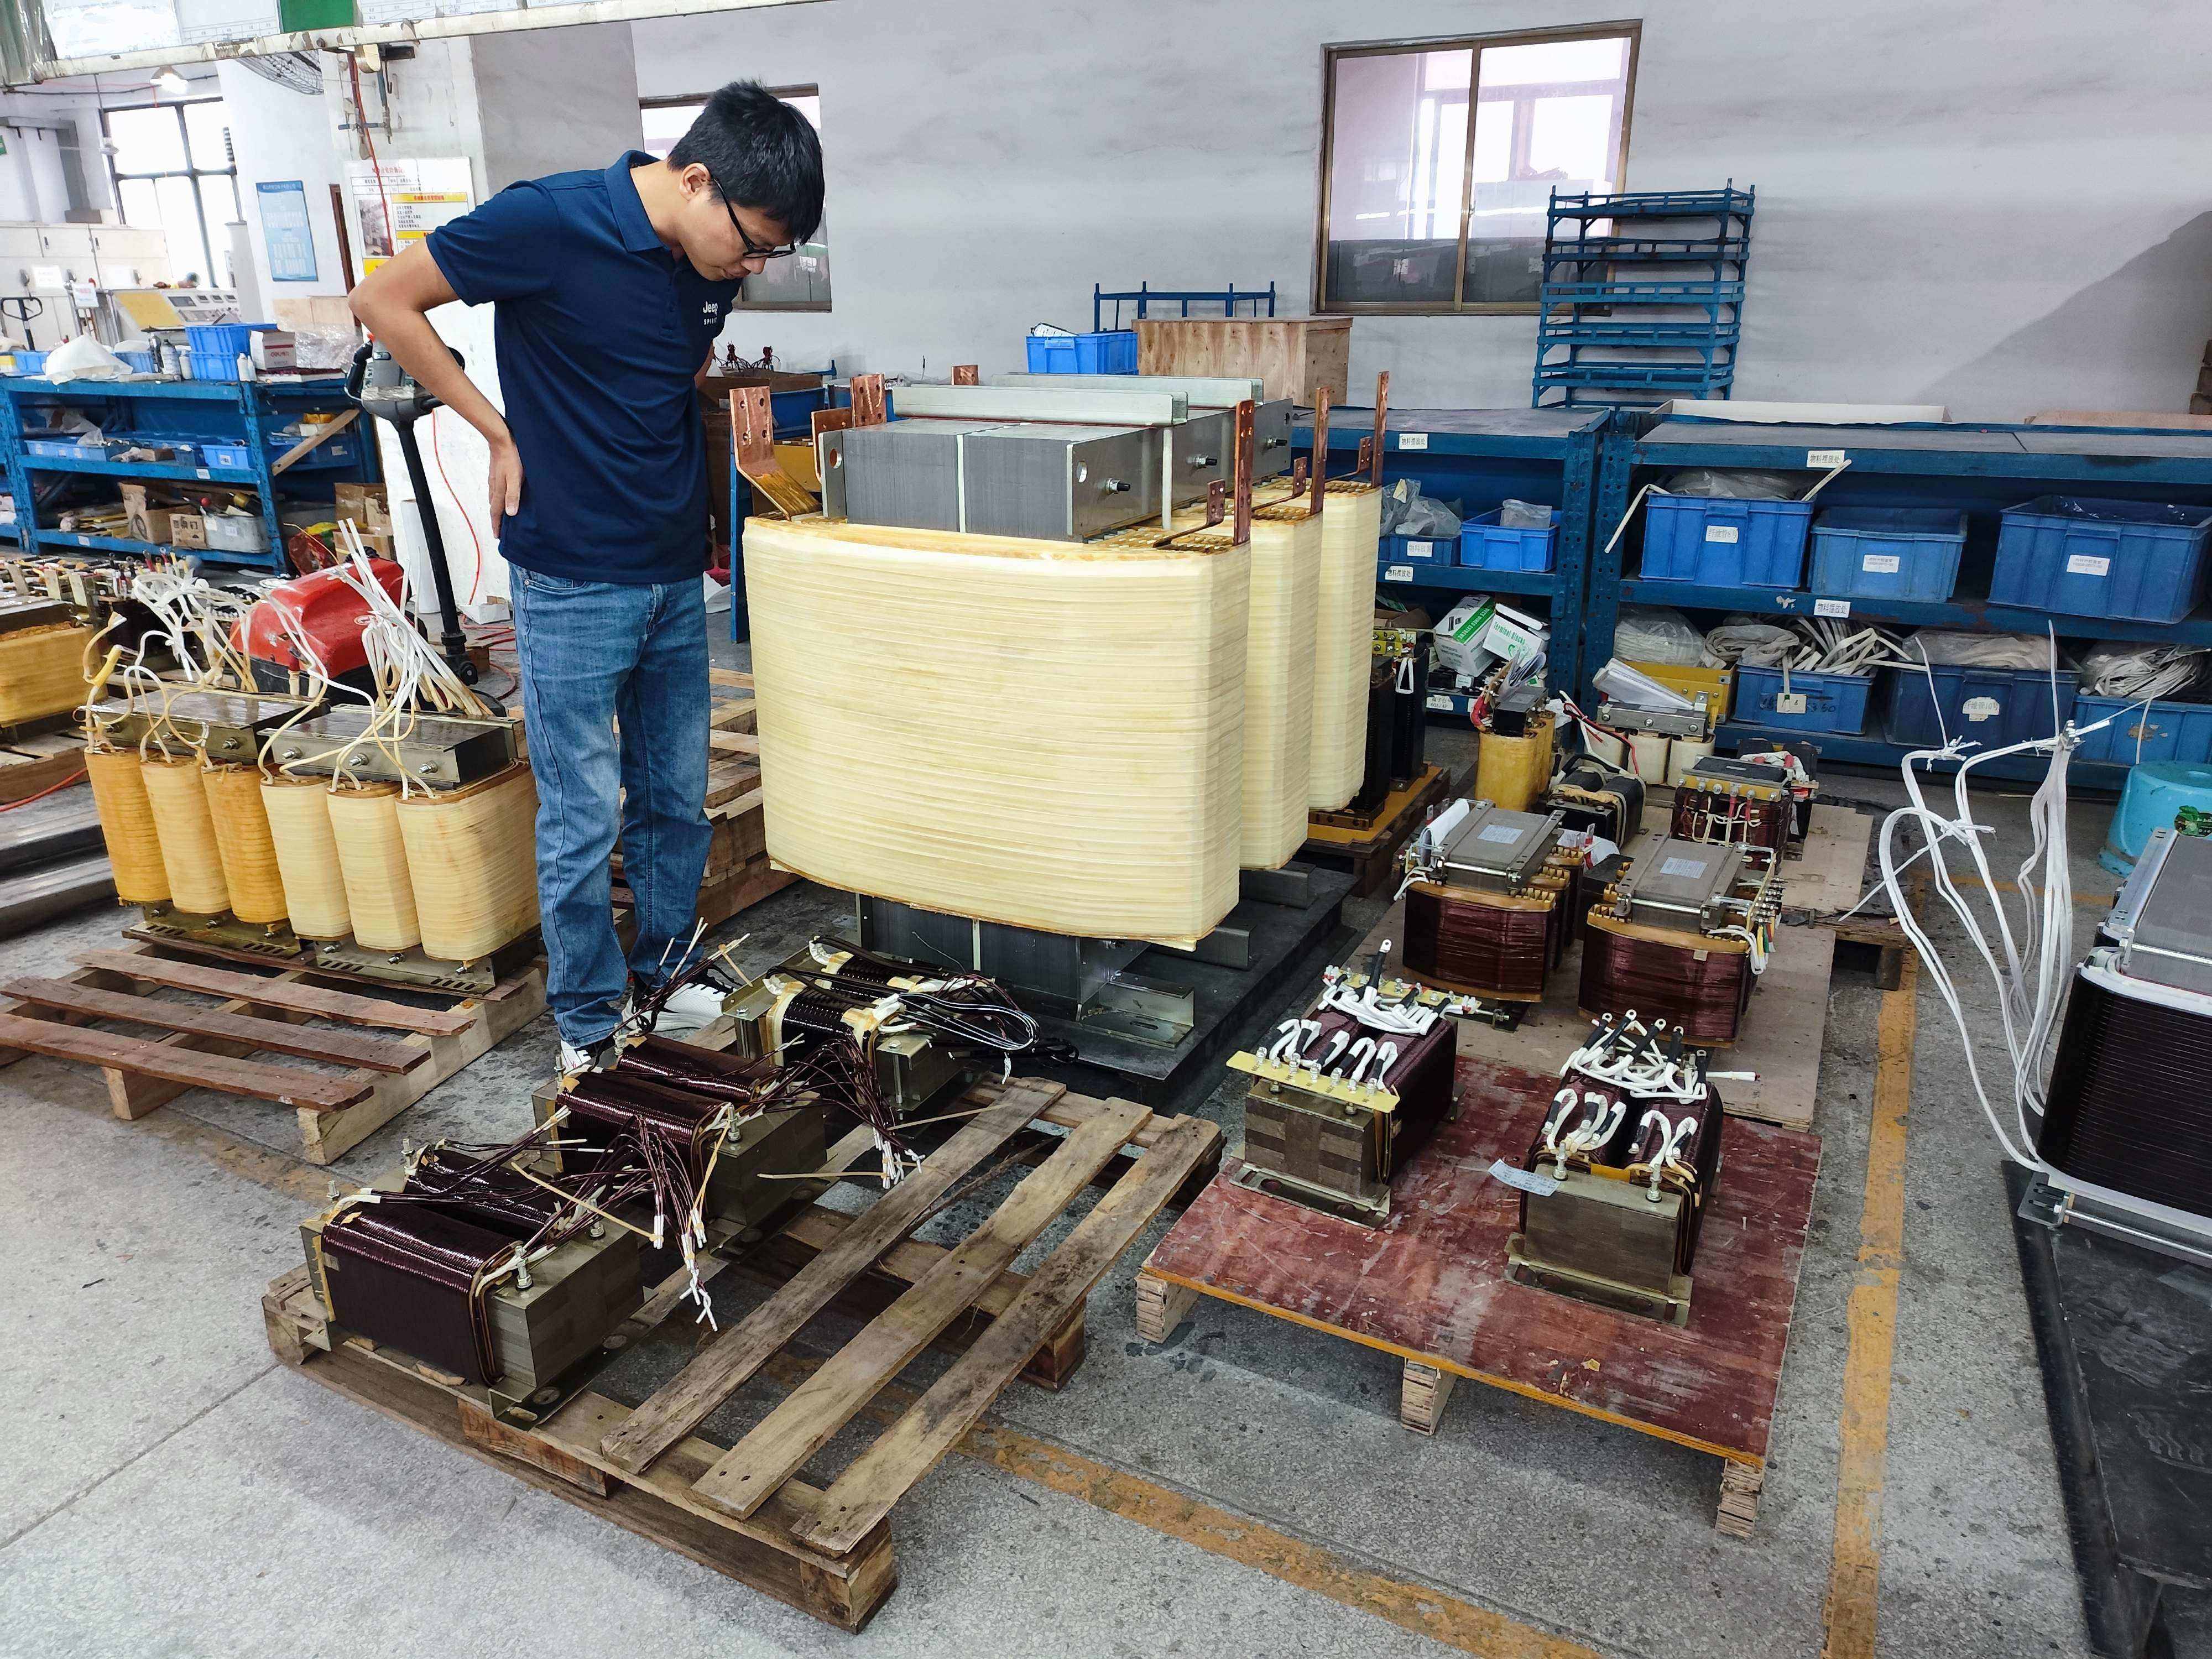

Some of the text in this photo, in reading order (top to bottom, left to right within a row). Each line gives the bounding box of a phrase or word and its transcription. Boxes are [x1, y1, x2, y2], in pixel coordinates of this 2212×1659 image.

[703, 301, 718, 316] Jeep
[1810, 453, 1840, 463] 物料摆放处
[1817, 602, 1846, 614] 物料摆放处
[1494, 622, 1511, 637] Terminal
